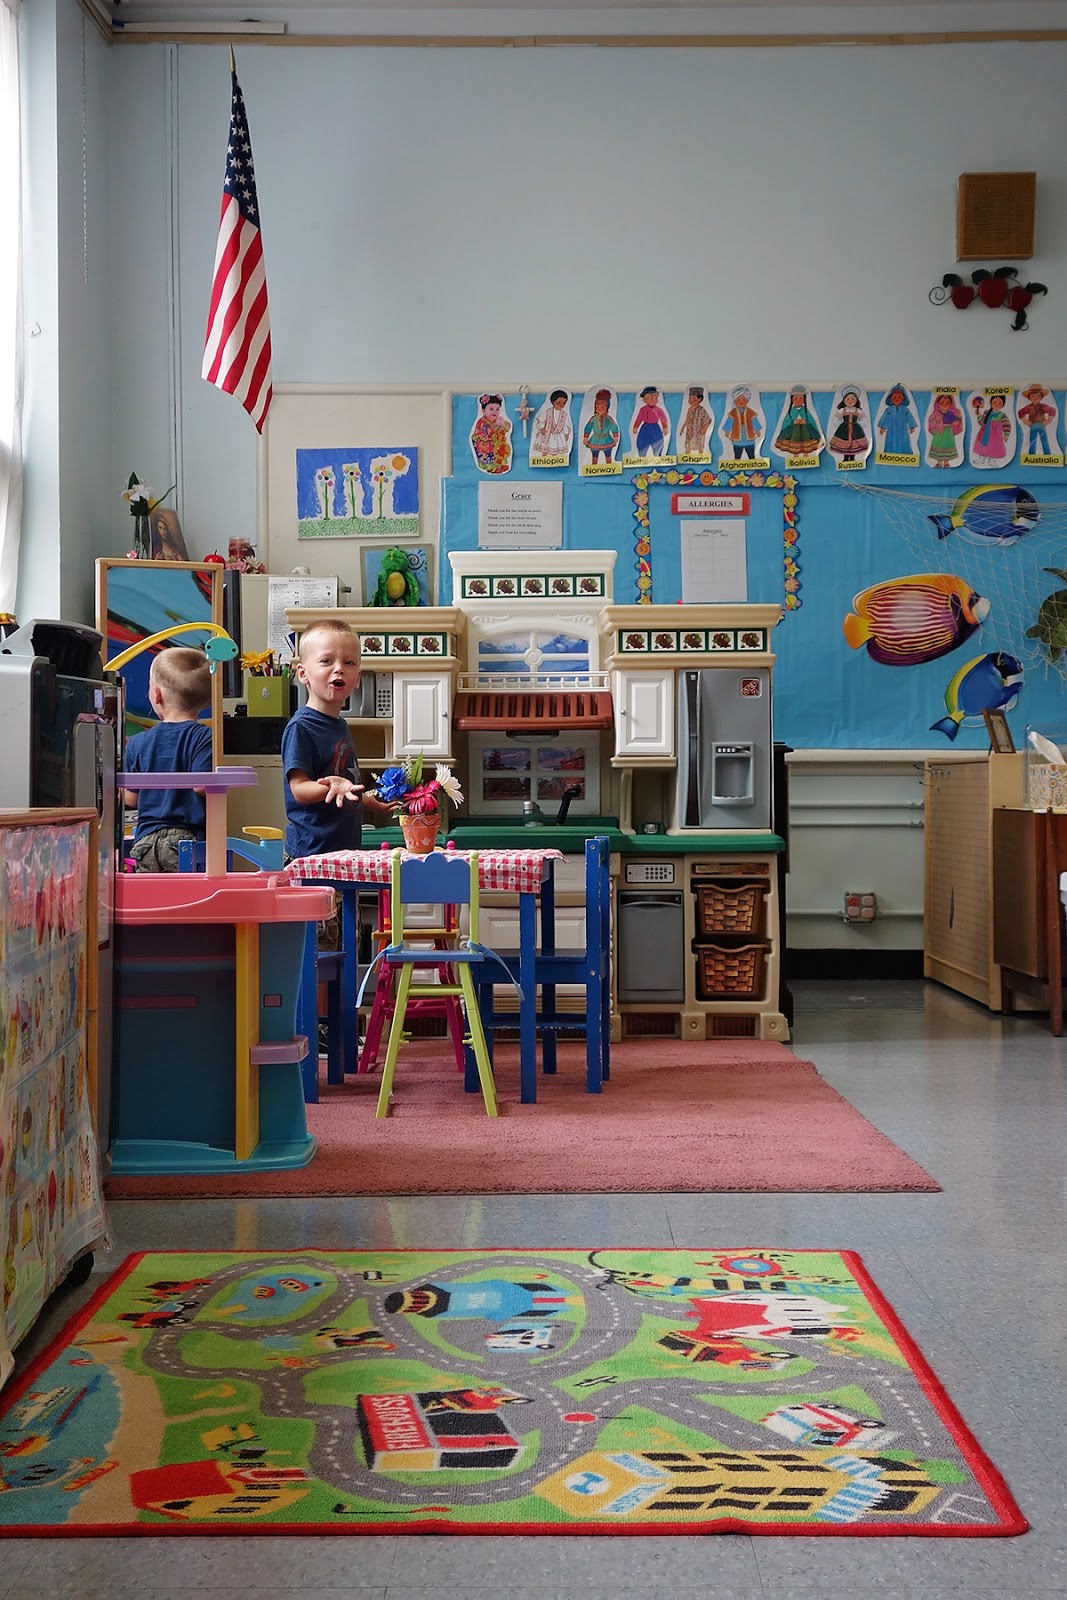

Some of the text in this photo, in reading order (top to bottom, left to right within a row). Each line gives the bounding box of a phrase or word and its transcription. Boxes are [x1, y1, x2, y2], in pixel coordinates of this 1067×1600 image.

[985, 387, 1010, 395] Korea
[532, 456, 564, 466] Ethiopia
[625, 457, 674, 465] Netherlands
[681, 455, 709, 463] Ghana
[879, 454, 917, 463] Morocco
[1024, 456, 1060, 464] Australia
[720, 460, 768, 470] Afghanistan
[789, 459, 816, 467] Bolivia
[585, 466, 616, 475] Norway
[511, 492, 532, 500] Grace
